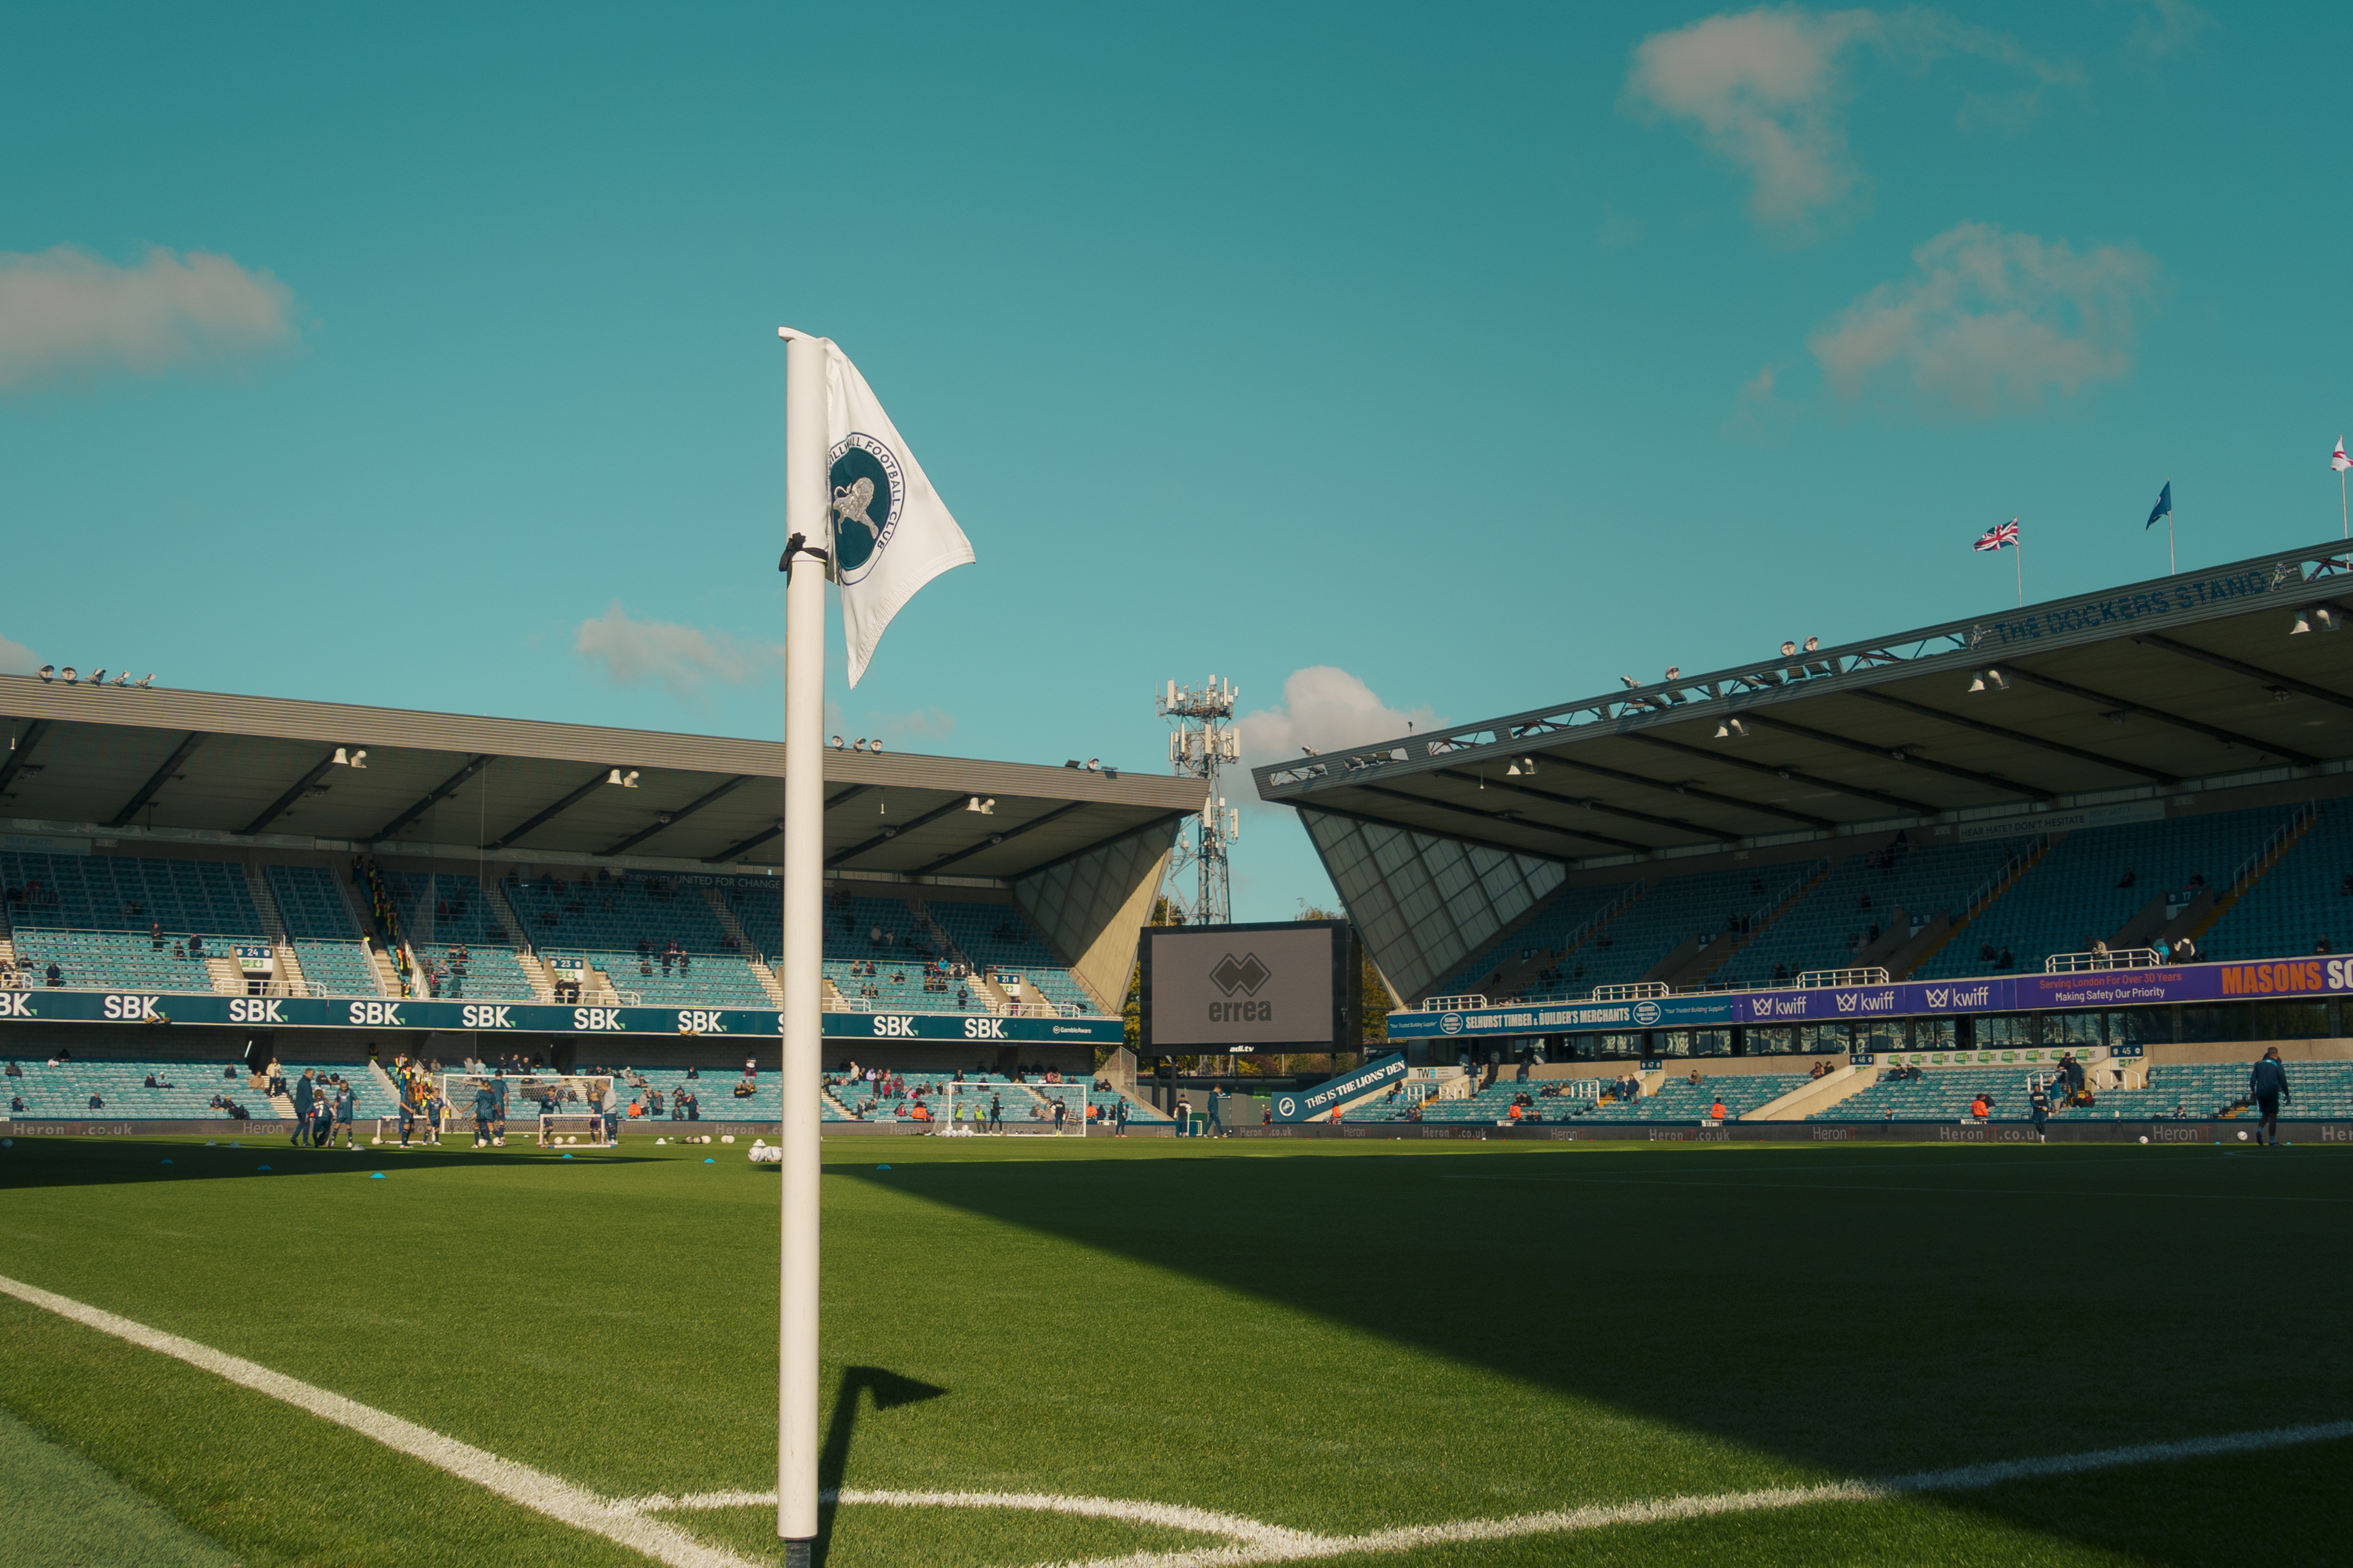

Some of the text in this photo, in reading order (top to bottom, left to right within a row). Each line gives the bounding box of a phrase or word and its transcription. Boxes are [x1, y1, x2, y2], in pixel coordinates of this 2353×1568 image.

[864, 440, 901, 506] FOOTBALL
[878, 511, 897, 550] CLUB
[1993, 571, 2265, 643] THE DOCKERS STAND
[2089, 806, 2131, 818] TEXT 66777
[1961, 827, 1983, 837] HEAR
[1986, 824, 2012, 835] HATE?
[2015, 820, 2042, 831] DON'T
[2045, 815, 2085, 827] HESITATE
[675, 874, 713, 886] UNITED
[715, 876, 735, 887] FOR
[738, 877, 781, 889] CHANGE
[2182, 891, 2192, 901] 17
[1923, 914, 1931, 923] 18
[247, 948, 259, 956] 24
[2039, 972, 2182, 990] Serving London For Over 30 Years
[2222, 961, 2322, 994] MASONS
[1861, 991, 1895, 1011] kwiff
[1953, 987, 1989, 1007] kwiff
[2056, 987, 2165, 1002] Making Safety Our Priority
[104, 995, 160, 1020] SBK
[229, 999, 283, 1023] SBK
[349, 1002, 401, 1025] SBK
[1776, 996, 1807, 1015] kwiff
[462, 1005, 512, 1028] SBK
[574, 1009, 621, 1030] SBK
[678, 1011, 723, 1032] SBK
[873, 1016, 914, 1037] SBK
[1465, 1007, 1630, 1029] SELHURST TIMBER & BUILDER'S MERCHANTS
[965, 1018, 1004, 1039] SBK
[1304, 1059, 1405, 1109] THIS IS THE LIONS' DEN
[13, 1123, 133, 1135] HeronIT.co.uk
[1240, 1127, 1291, 1138] HeronIT.co.uk
[1344, 1126, 1372, 1137] HeronIT
[1423, 1126, 1486, 1138] HeronIT.co.uk
[1551, 1127, 1586, 1140] HeronIT
[1649, 1129, 1730, 1141] HeronIT.co.uk
[1812, 1126, 1858, 1140] HeronIT
[2153, 1125, 2212, 1141] HeronIT
